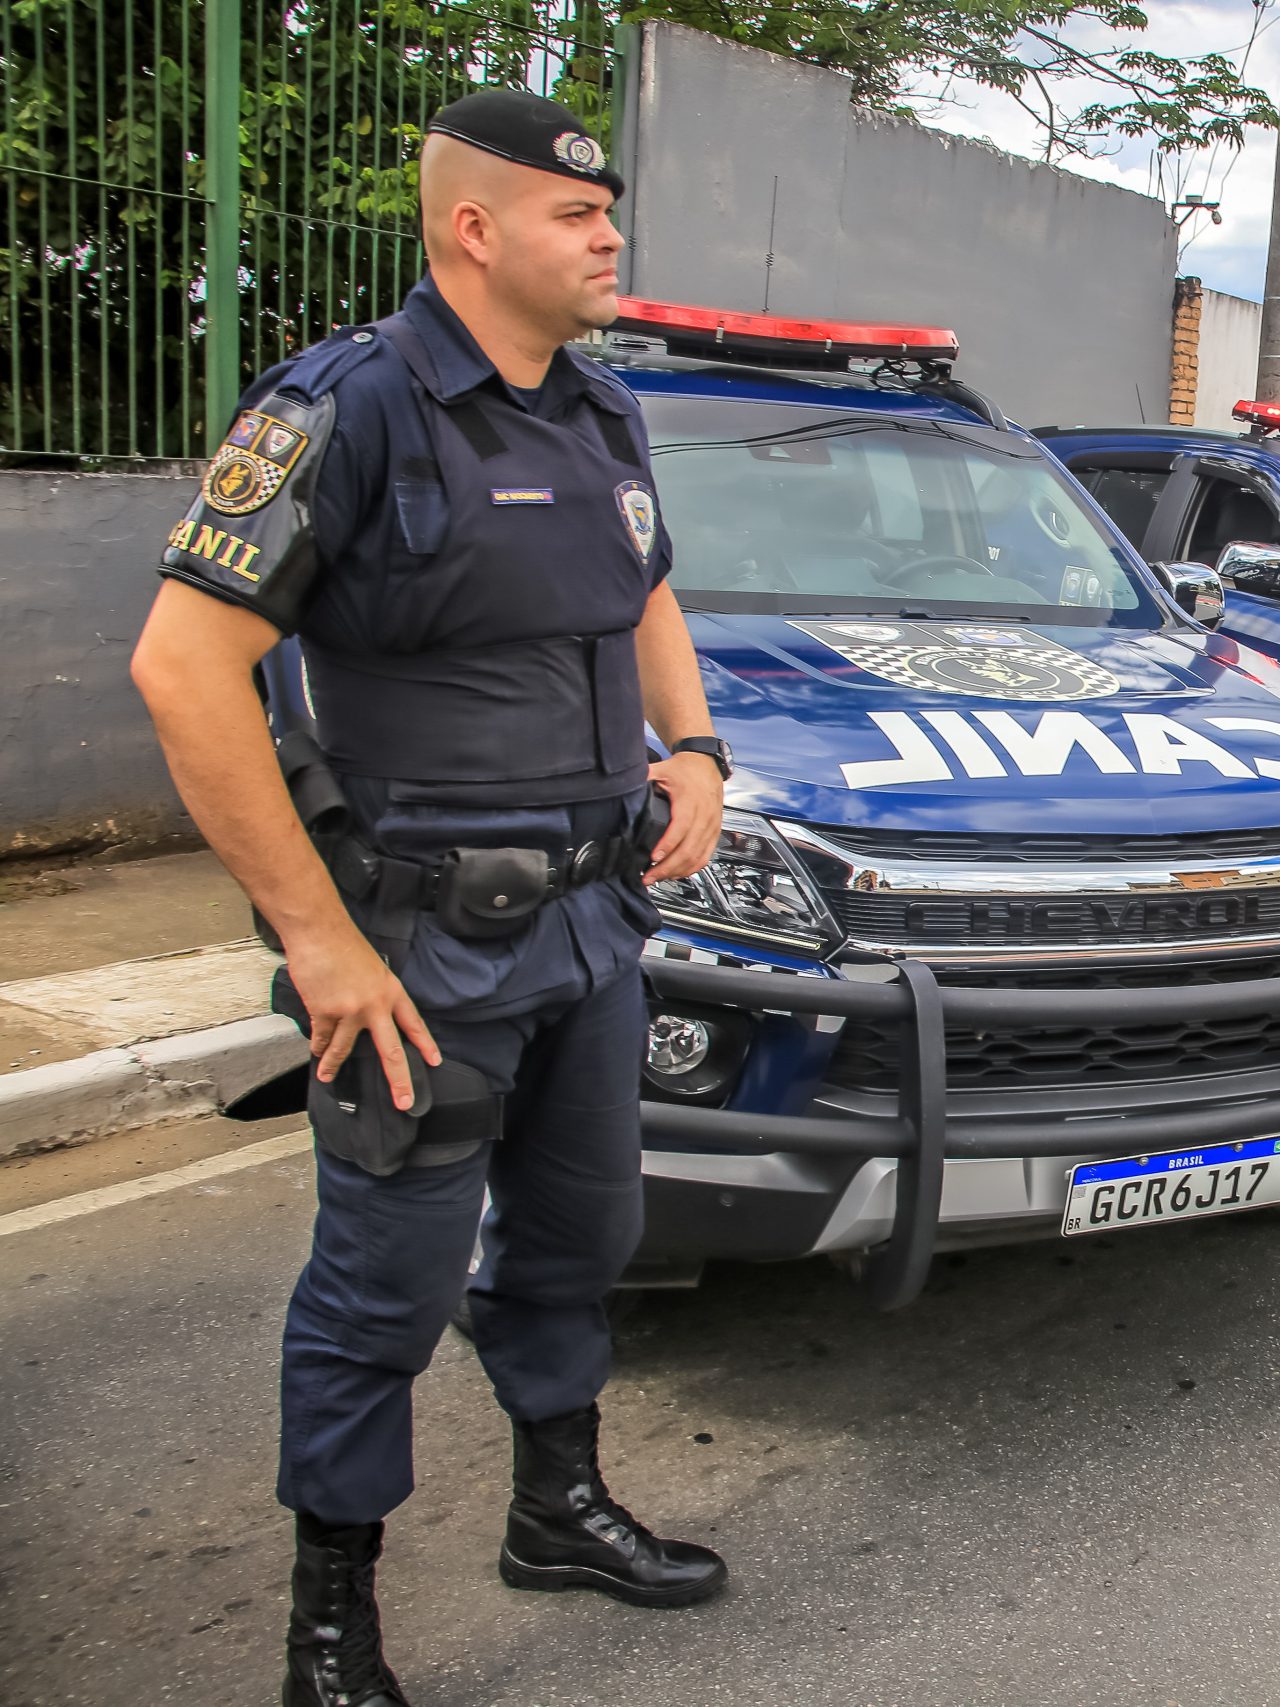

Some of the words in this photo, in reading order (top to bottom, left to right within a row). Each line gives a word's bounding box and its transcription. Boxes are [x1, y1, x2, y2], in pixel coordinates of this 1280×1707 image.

[1168, 1155, 1204, 1169] BRASIL
[1089, 1162, 1270, 1224] GCR6J17
[1067, 1217, 1081, 1230] BR
